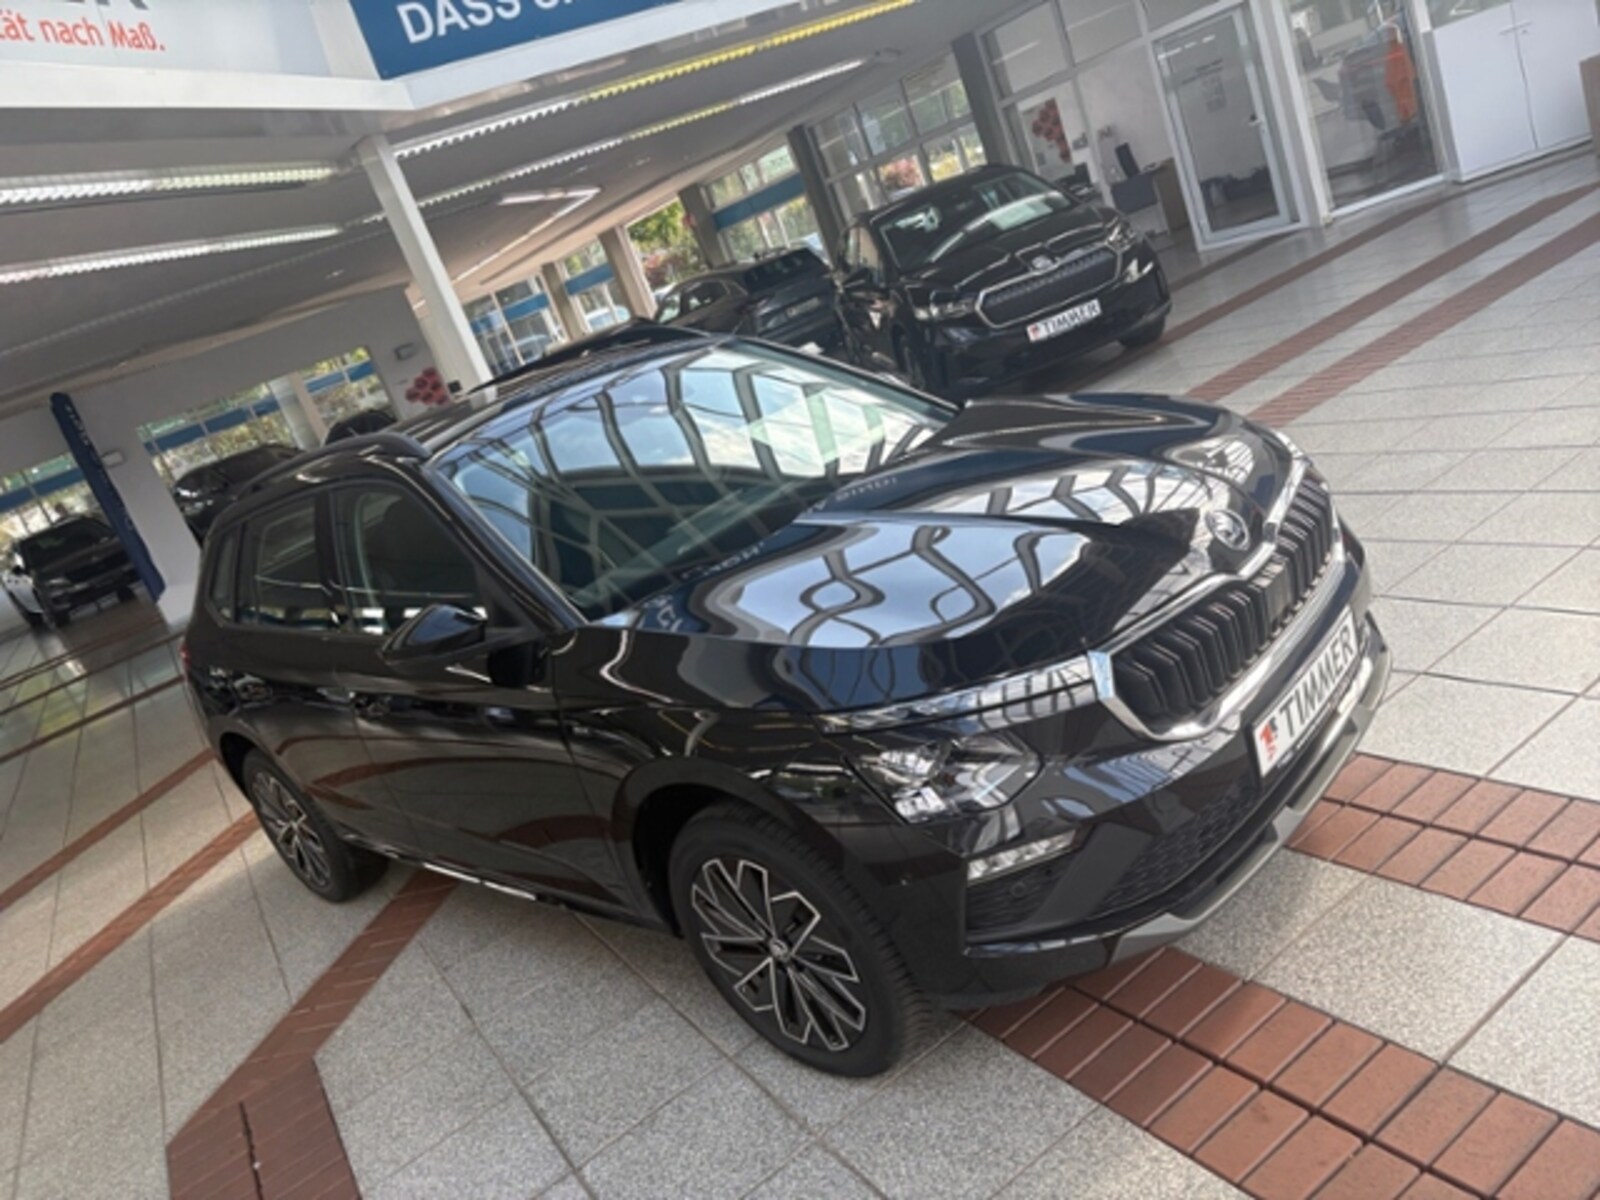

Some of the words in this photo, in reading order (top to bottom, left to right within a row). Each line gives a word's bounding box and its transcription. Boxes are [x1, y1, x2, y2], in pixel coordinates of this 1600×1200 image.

[0, 9, 35, 42] ät
[38, 16, 105, 46] nach
[107, 20, 166, 51] Maß.
[1279, 626, 1354, 738] TIMMER
